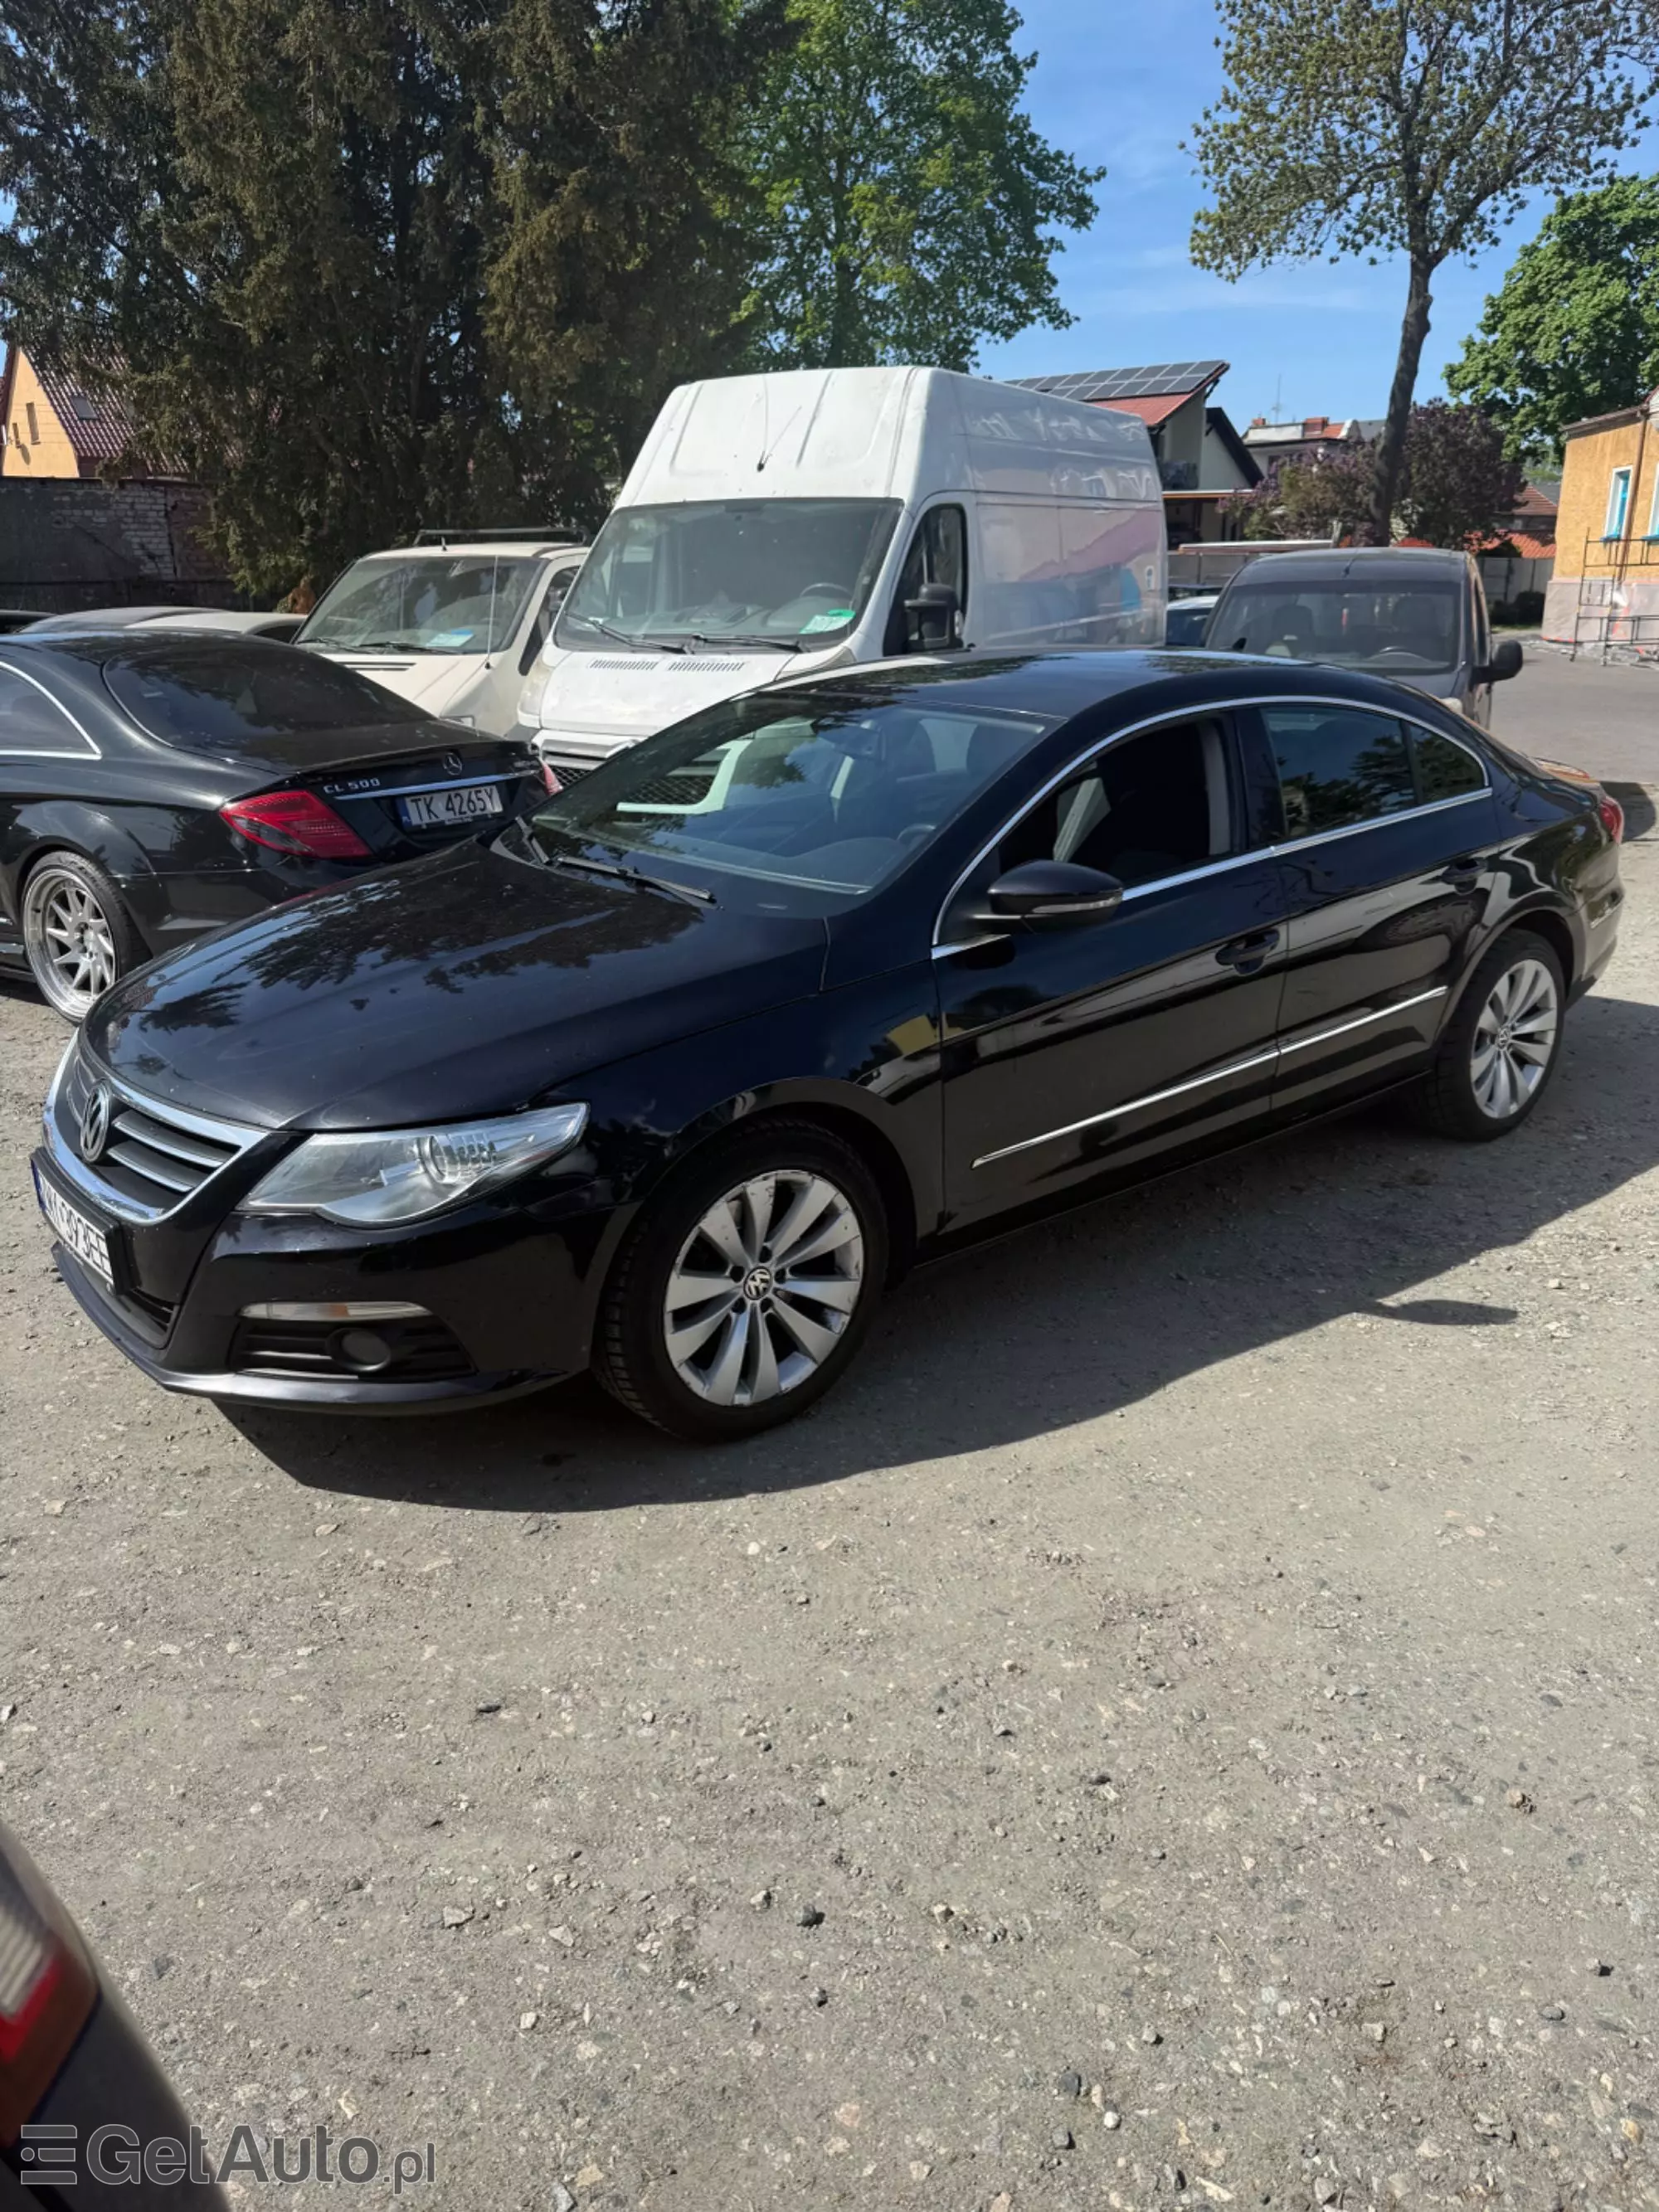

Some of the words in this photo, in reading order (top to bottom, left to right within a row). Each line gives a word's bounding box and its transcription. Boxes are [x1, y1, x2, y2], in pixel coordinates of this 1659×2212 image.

[323, 784, 345, 794] CL
[348, 777, 381, 790] 500
[411, 796, 440, 822] TK
[445, 787, 495, 816] 4265Y
